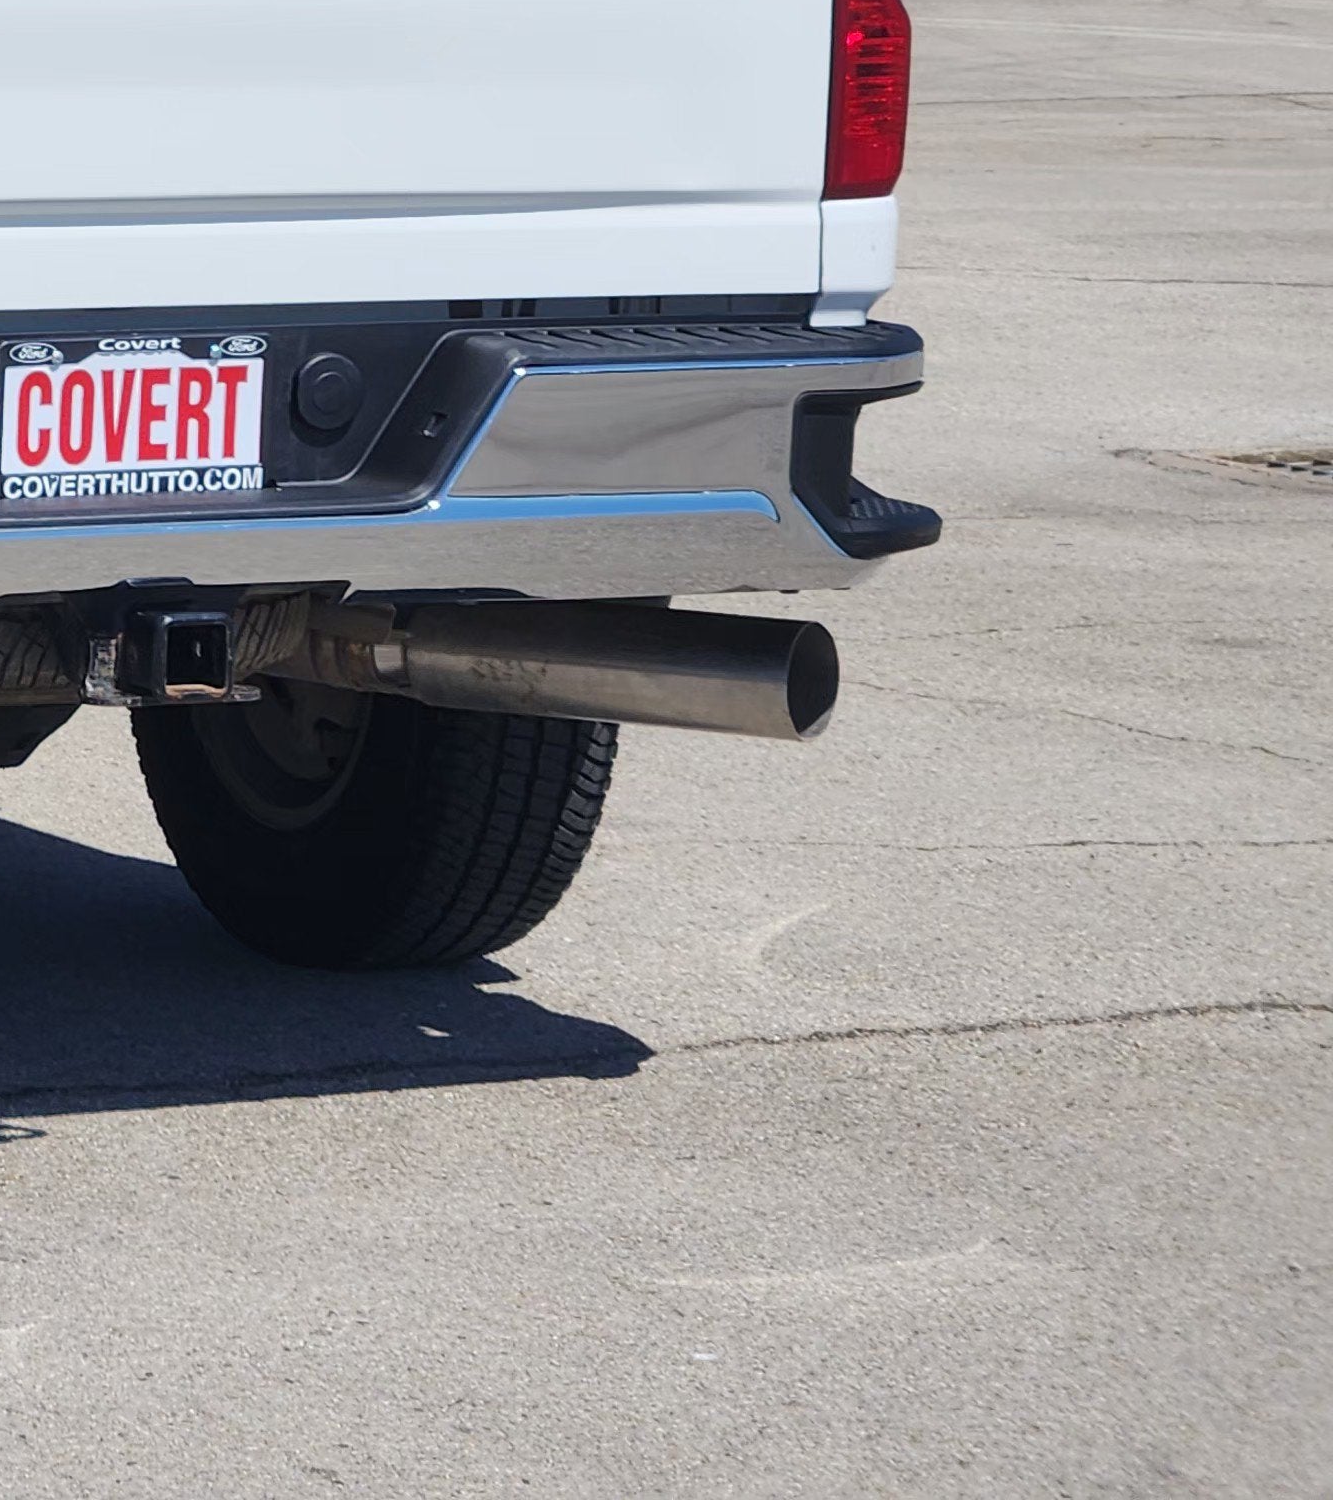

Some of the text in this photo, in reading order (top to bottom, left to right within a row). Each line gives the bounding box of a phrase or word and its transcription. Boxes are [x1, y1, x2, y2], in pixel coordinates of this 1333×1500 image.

[97, 336, 182, 353] Covert
[16, 364, 250, 467] COVERT
[2, 466, 264, 500] COVERTHUTTO.COM
